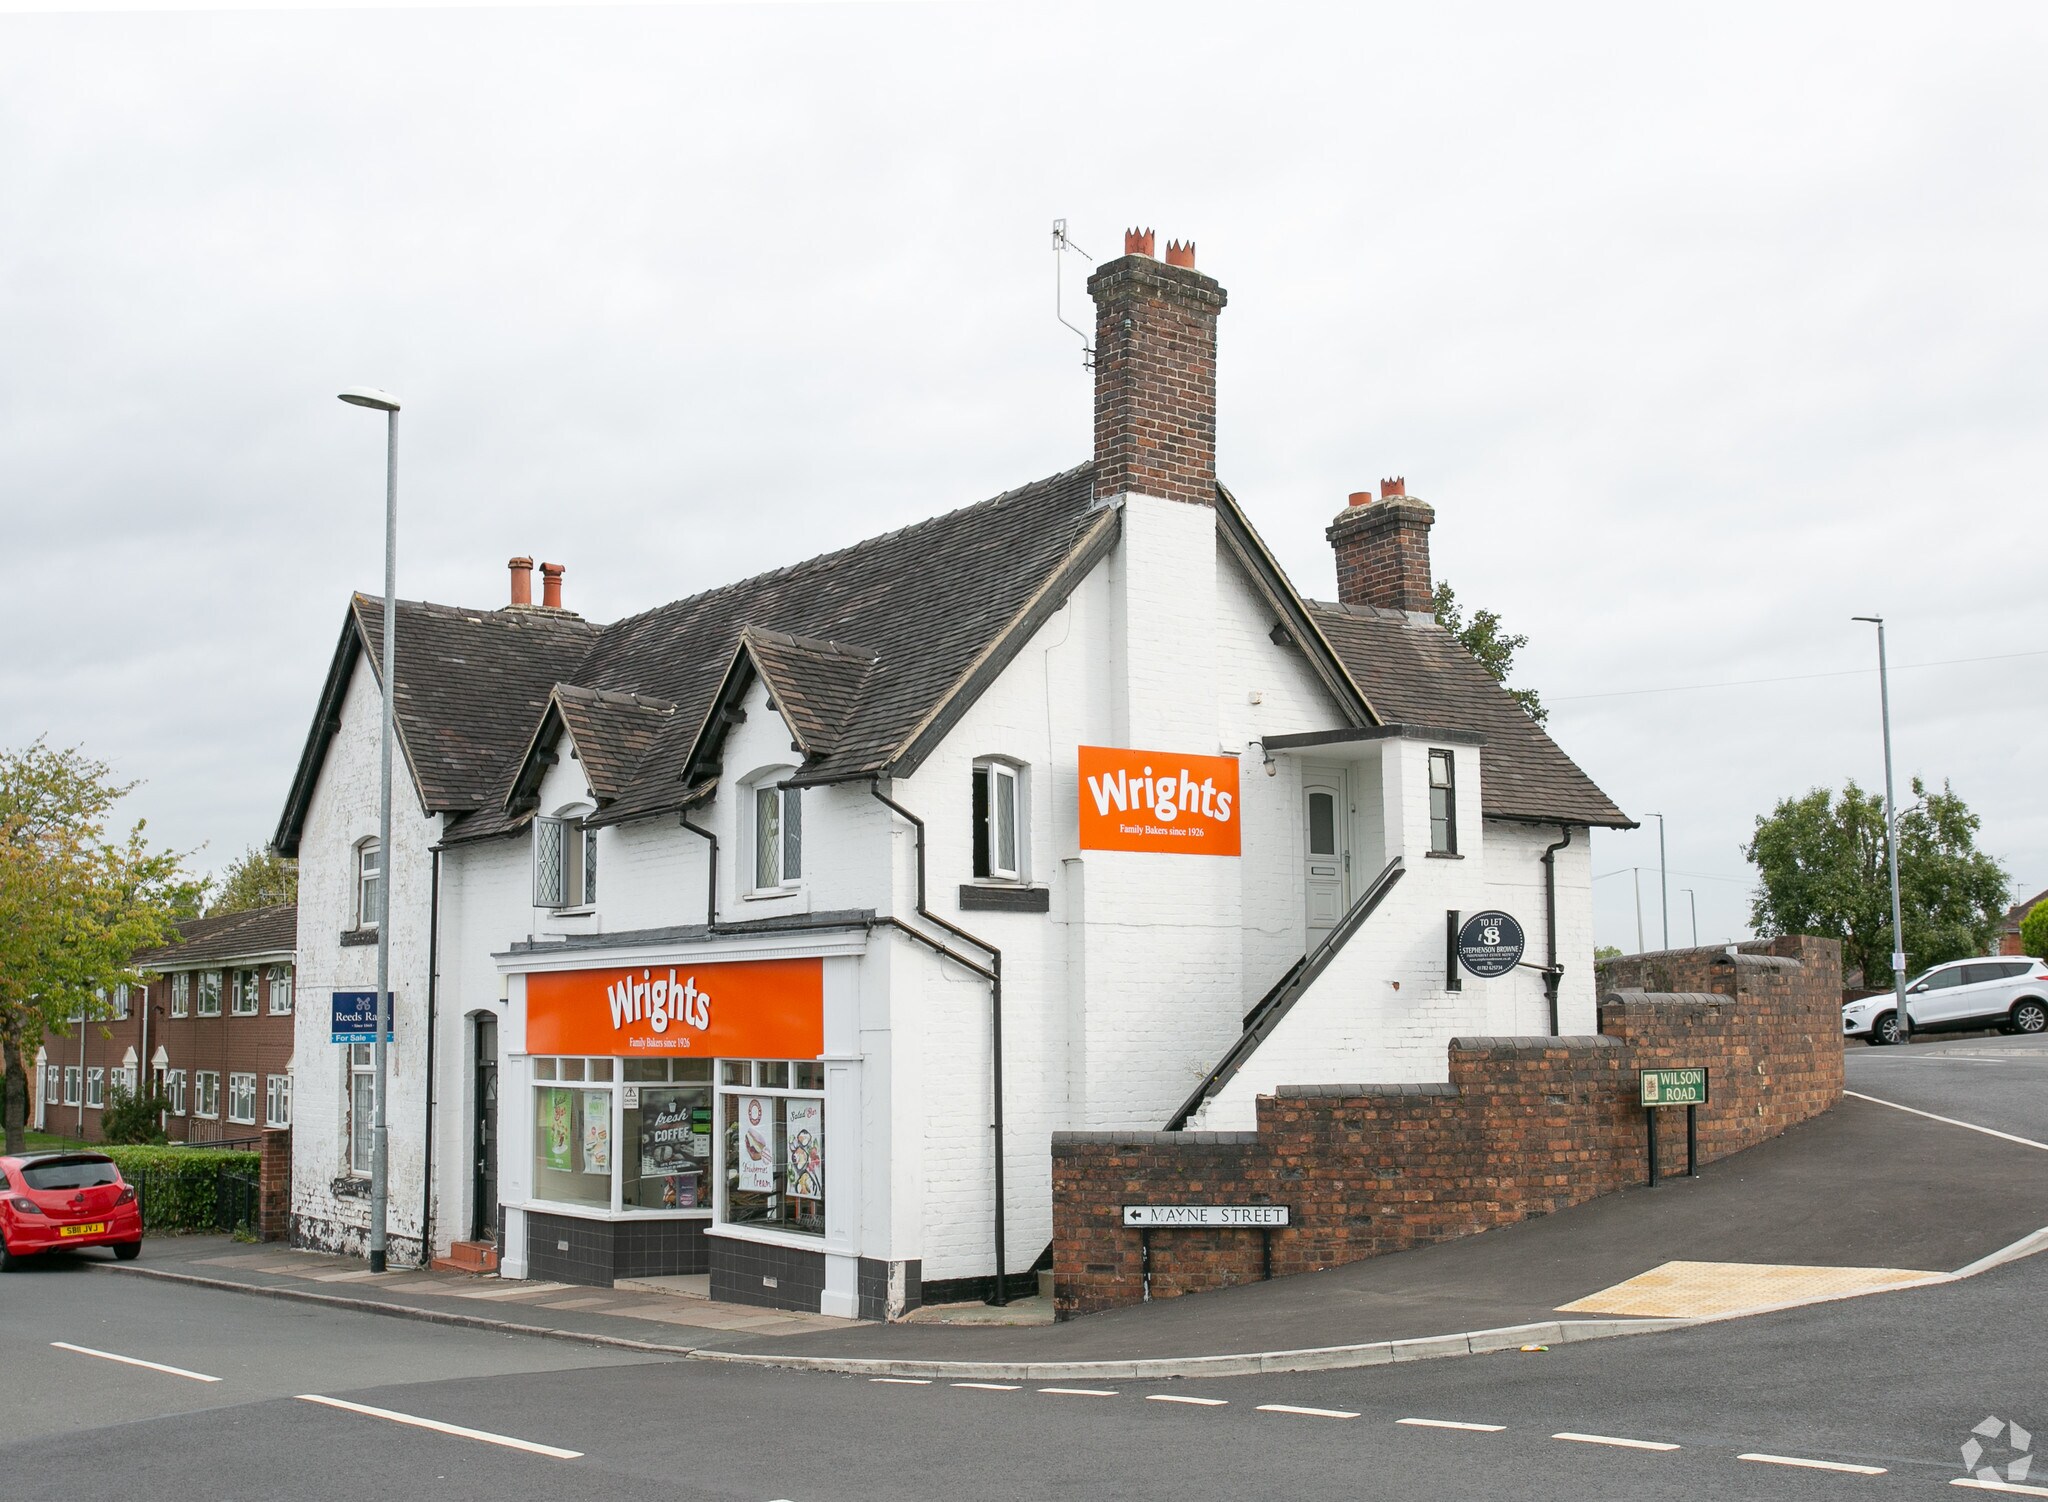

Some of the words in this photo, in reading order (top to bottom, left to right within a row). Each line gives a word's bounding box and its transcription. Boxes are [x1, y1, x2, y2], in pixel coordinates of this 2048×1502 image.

[1087, 766, 1232, 822] Wrights
[1119, 823, 1144, 836] Family
[1145, 825, 1168, 835] Bakers
[1169, 826, 1186, 836] since
[1187, 827, 1204, 837] 1926
[1479, 918, 1489, 927] TO
[1490, 918, 1503, 926] LET
[1462, 946, 1495, 954] STEPHENSON
[1496, 945, 1519, 953] BROWNE
[607, 968, 710, 1033] Wrights
[336, 1012, 362, 1021] Reeds
[366, 1012, 390, 1021] Ras
[335, 1034, 349, 1042] For
[350, 1034, 367, 1042] Sale
[629, 1037, 646, 1049] Family
[646, 1038, 663, 1047] Bakers
[663, 1038, 677, 1047] since
[677, 1037, 690, 1048] 1926
[1660, 1071, 1701, 1085] WILSON
[1666, 1087, 1696, 1101] ROAD
[654, 1107, 689, 1127] fresh
[791, 1108, 806, 1121] Salad
[807, 1107, 816, 1118] Bar
[654, 1126, 690, 1143] COFFEE
[753, 1173, 772, 1188] Cream
[1150, 1208, 1208, 1222] MAYNE
[1221, 1208, 1284, 1223] STREET
[67, 1226, 81, 1234] SB11
